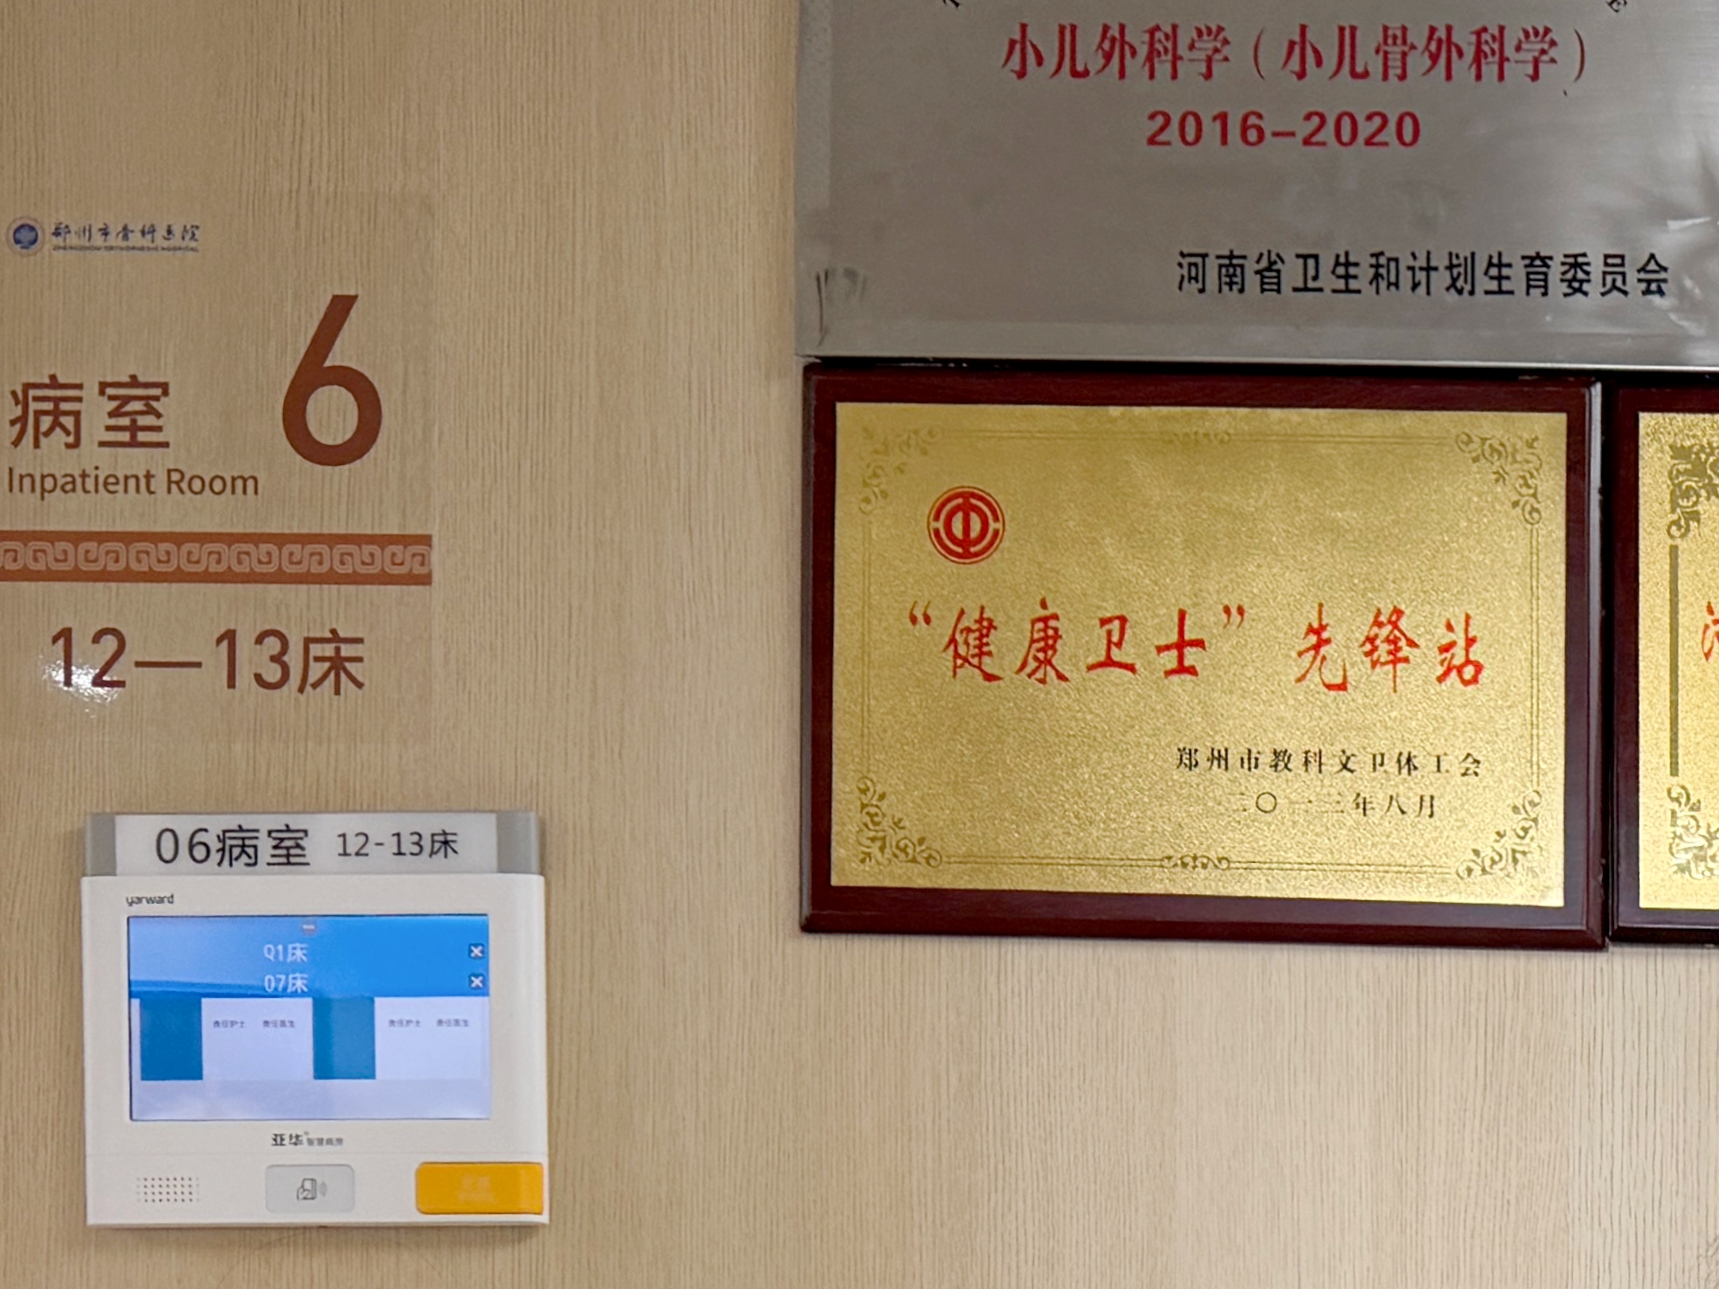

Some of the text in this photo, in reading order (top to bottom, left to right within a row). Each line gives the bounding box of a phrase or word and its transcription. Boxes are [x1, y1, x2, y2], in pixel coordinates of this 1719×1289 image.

[1000, 23, 1589, 84] 小儿外科学（小儿骨外科学）
[1176, 250, 1671, 298] 河南省卫生和计划生育委员会
[282, 294, 383, 466] 6
[9, 374, 170, 450] 病室
[7, 467, 260, 501] Inpatient Room
[1176, 747, 1482, 777] 郑州市教科文卫体工会
[155, 824, 459, 868] 06病室 12-13床
